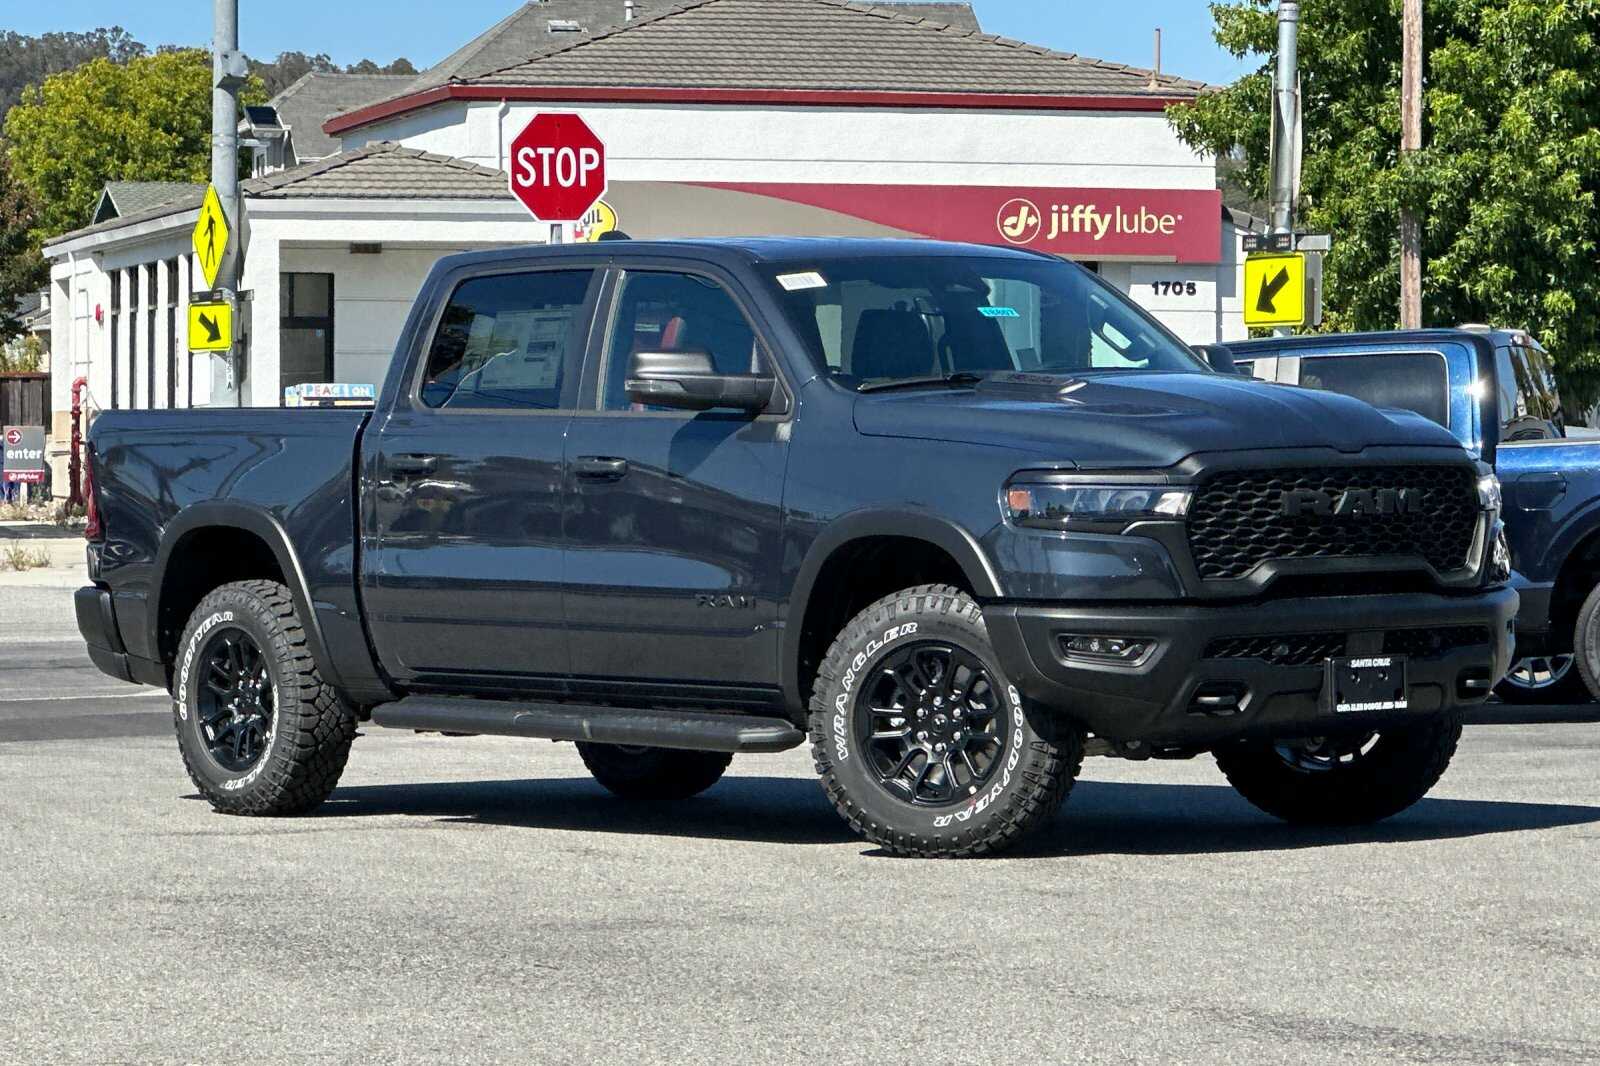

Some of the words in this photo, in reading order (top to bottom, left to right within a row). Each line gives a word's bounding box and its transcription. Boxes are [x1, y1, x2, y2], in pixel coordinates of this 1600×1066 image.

[516, 147, 600, 187] STOP
[1046, 204, 1113, 241] jiffy
[1115, 205, 1176, 235] lube
[1151, 280, 1197, 297] 1705
[6, 447, 42, 460] enter
[1280, 488, 1425, 516] RAM
[1351, 659, 1372, 668] SANTA
[1373, 657, 1391, 667] CRUZ
[833, 622, 918, 761] WRANGLER
[933, 684, 1024, 828] GOODYEAR
